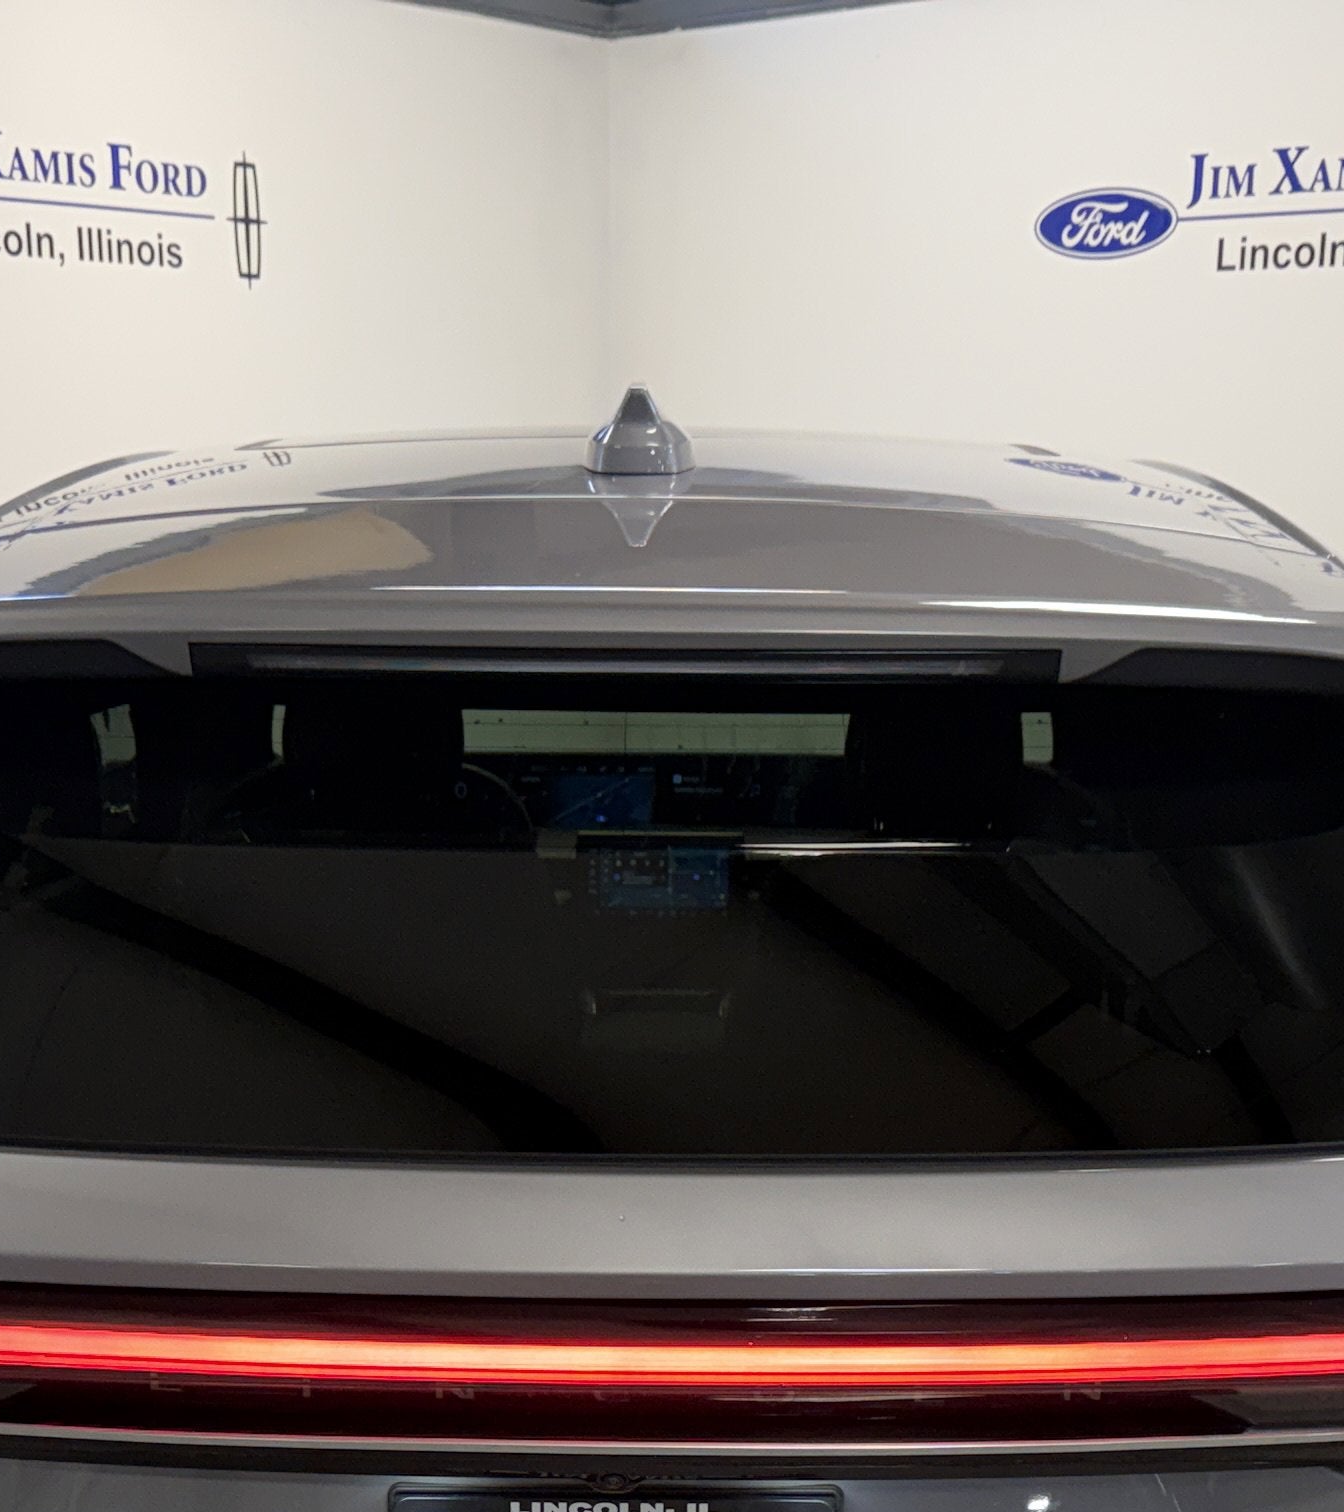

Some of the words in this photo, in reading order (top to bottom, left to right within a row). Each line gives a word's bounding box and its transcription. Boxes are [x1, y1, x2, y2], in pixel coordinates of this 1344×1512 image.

[107, 143, 208, 198] FORD
[1186, 152, 1258, 209] JIM
[77, 227, 184, 269] Illinois
[1060, 200, 1148, 249] Ford
